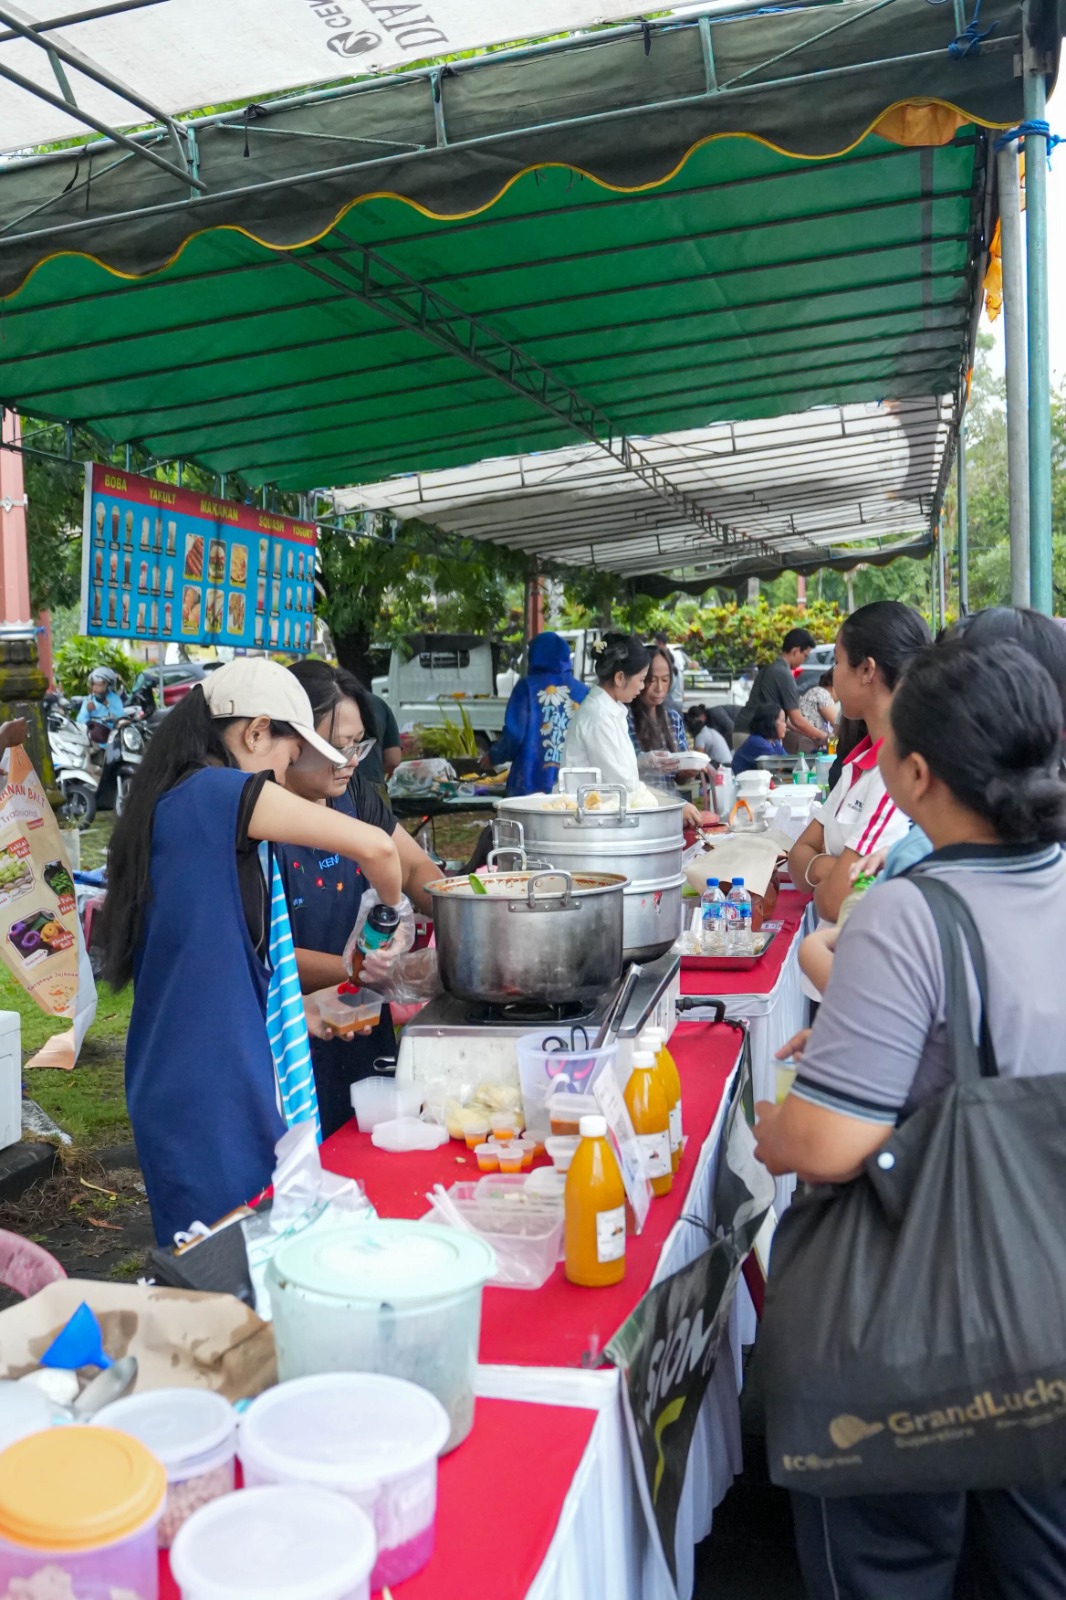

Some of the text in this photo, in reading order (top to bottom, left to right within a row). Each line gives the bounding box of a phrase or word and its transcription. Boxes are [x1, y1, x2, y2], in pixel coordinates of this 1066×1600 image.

[361, 0, 450, 50] DIA
[104, 474, 127, 492] BOBA
[149, 487, 176, 505] YAKULT
[201, 499, 238, 521] MAKANAN
[259, 515, 285, 532] SQUASH
[292, 525, 313, 539] YOGURT
